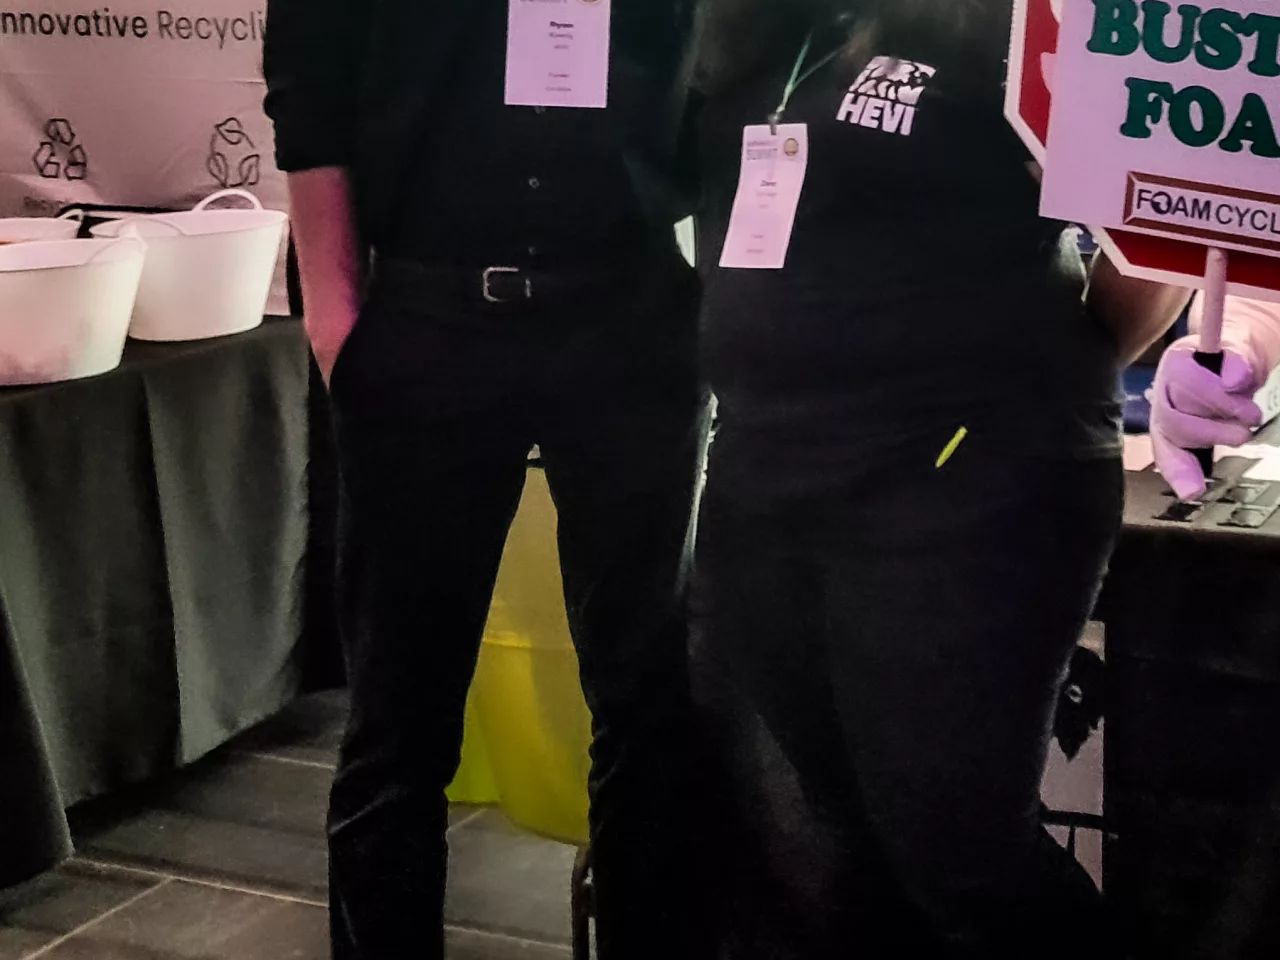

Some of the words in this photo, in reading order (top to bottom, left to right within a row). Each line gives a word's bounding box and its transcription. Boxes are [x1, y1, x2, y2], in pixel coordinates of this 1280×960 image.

[0, 7, 149, 39] nnovative
[156, 10, 267, 50] Recycli
[836, 92, 916, 136] HEVI
